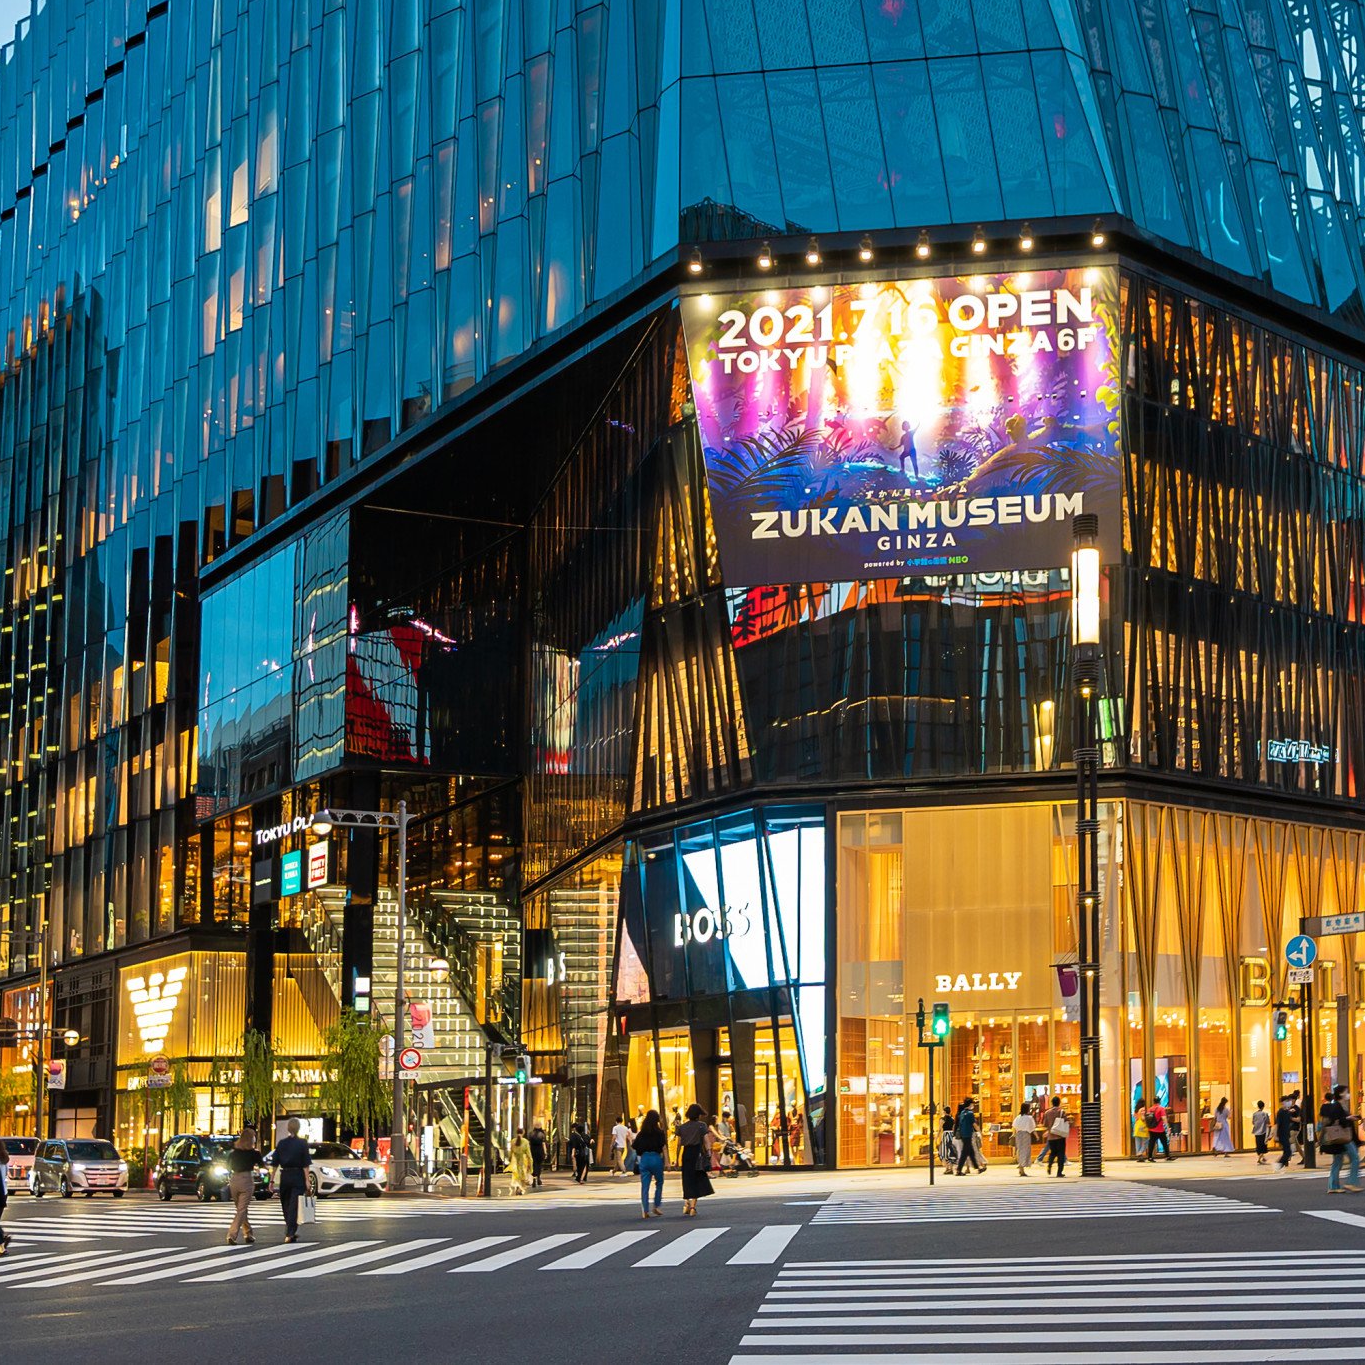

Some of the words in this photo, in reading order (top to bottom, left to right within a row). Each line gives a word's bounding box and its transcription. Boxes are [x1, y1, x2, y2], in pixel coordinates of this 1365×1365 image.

[717, 293, 939, 349] 2021.716
[948, 287, 1095, 331] OPEN
[717, 345, 828, 375] TOKYU
[835, 337, 944, 368] PAZA
[949, 330, 1054, 358] GINZA
[1057, 327, 1097, 351] 6F
[750, 503, 899, 540] ZUKAN
[907, 491, 1085, 531] MUSEUM
[877, 532, 957, 551] GINZA
[864, 559, 895, 569] powered
[896, 559, 905, 567] by
[948, 555, 969, 565] NEO
[255, 822, 291, 845] TOKYU
[674, 902, 751, 947] BOSS
[935, 971, 1023, 993] BALLY
